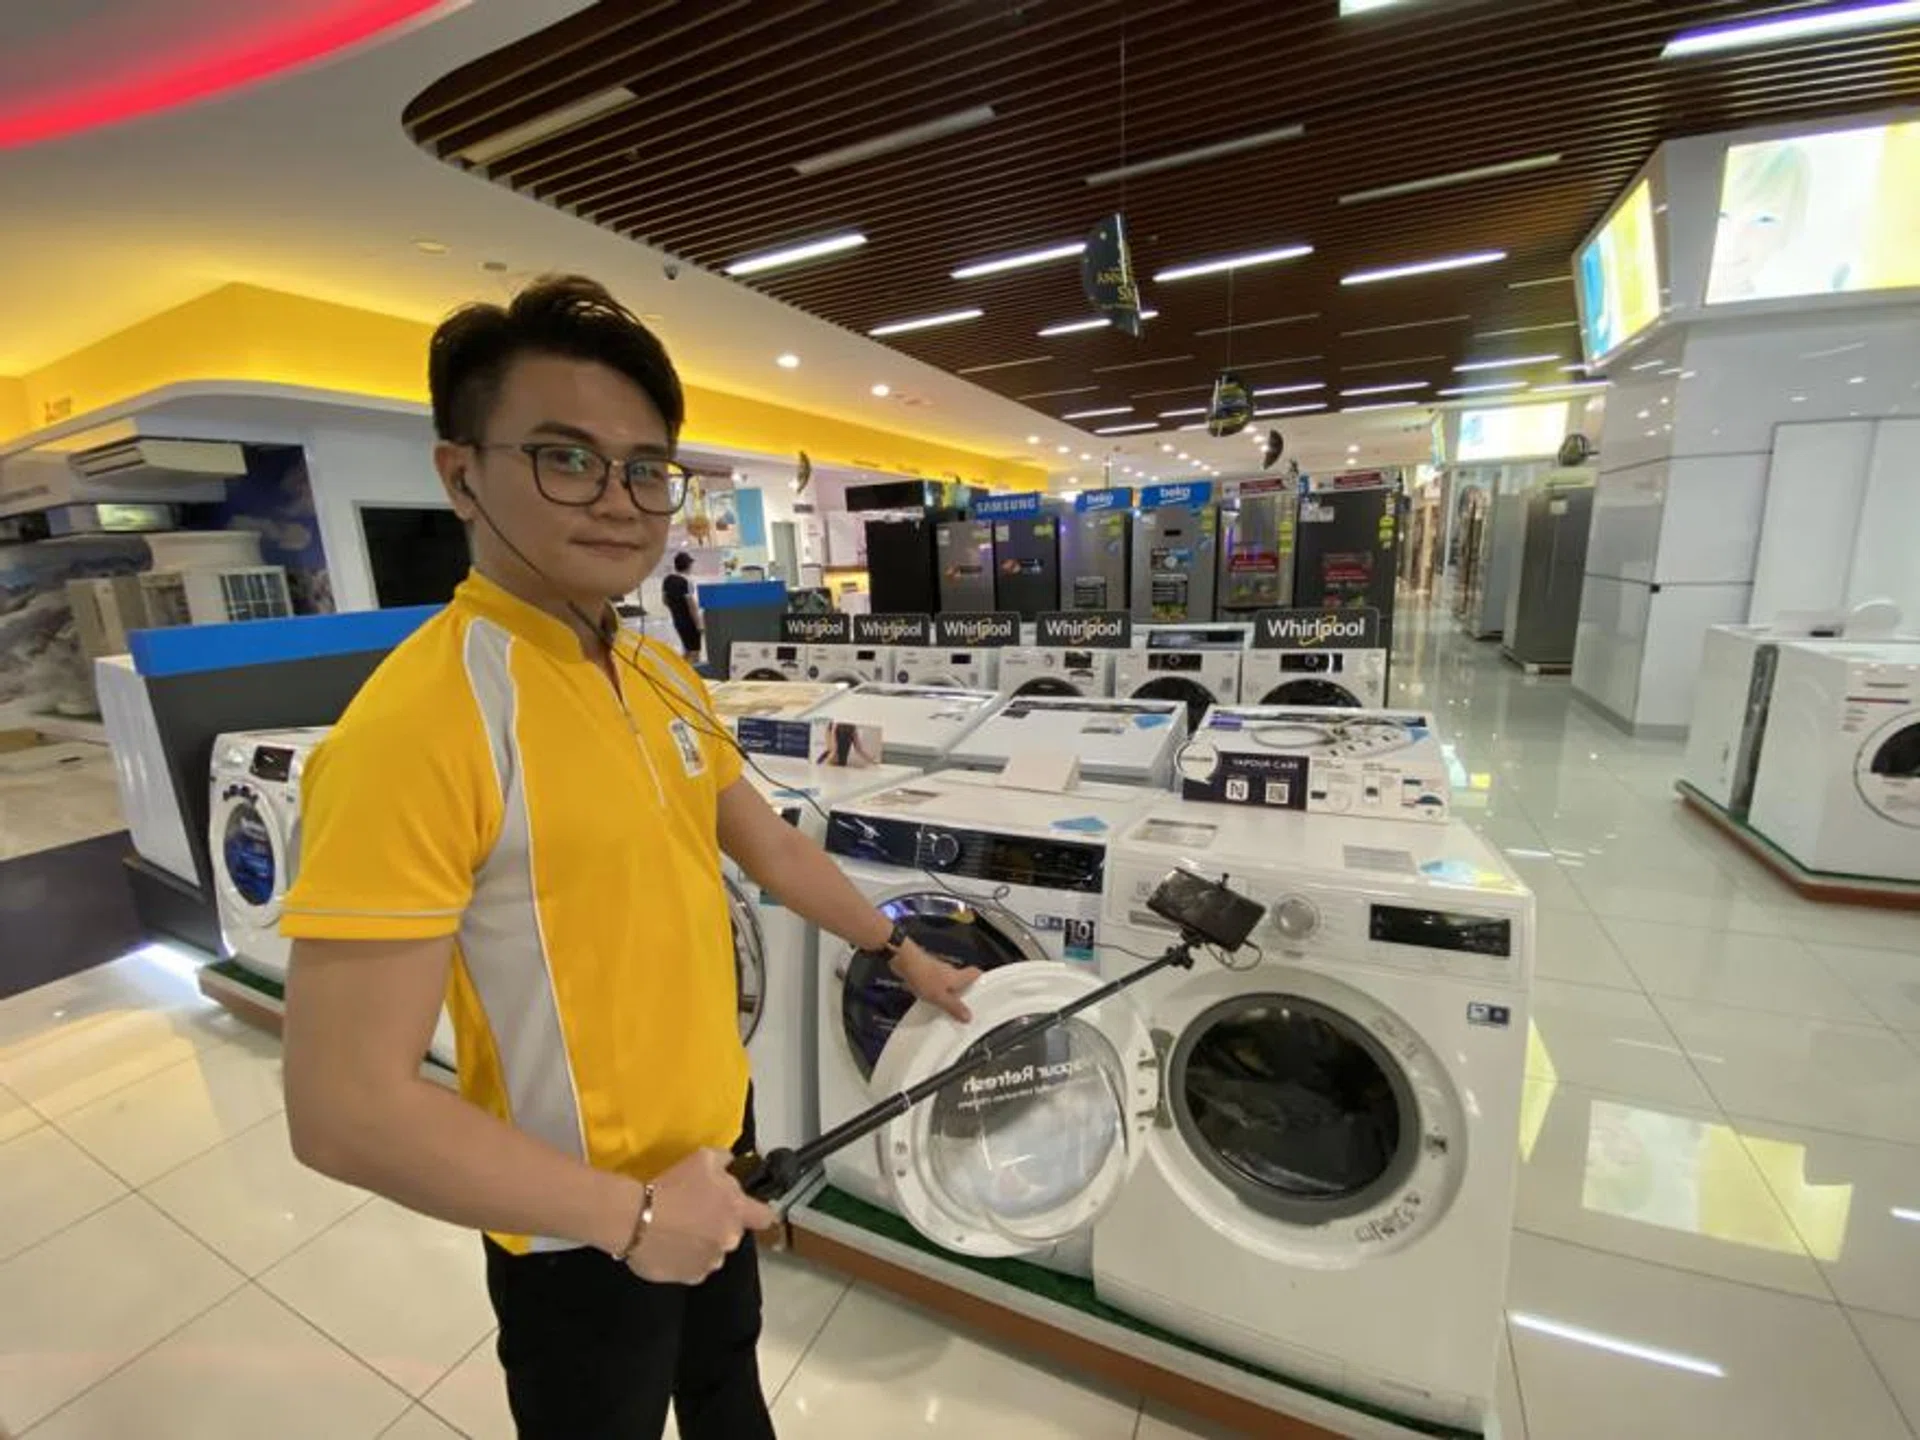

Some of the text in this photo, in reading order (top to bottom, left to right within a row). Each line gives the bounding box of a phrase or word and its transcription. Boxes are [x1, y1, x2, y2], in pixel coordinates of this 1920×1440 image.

[976, 498, 1036, 513] SAMSUNG
[787, 619, 844, 639] Whirlpool
[861, 620, 922, 639] Whirlpool
[944, 619, 1012, 639] Whirlpool
[1045, 618, 1122, 639] Whirlpool
[1267, 617, 1365, 641] Whirlpool
